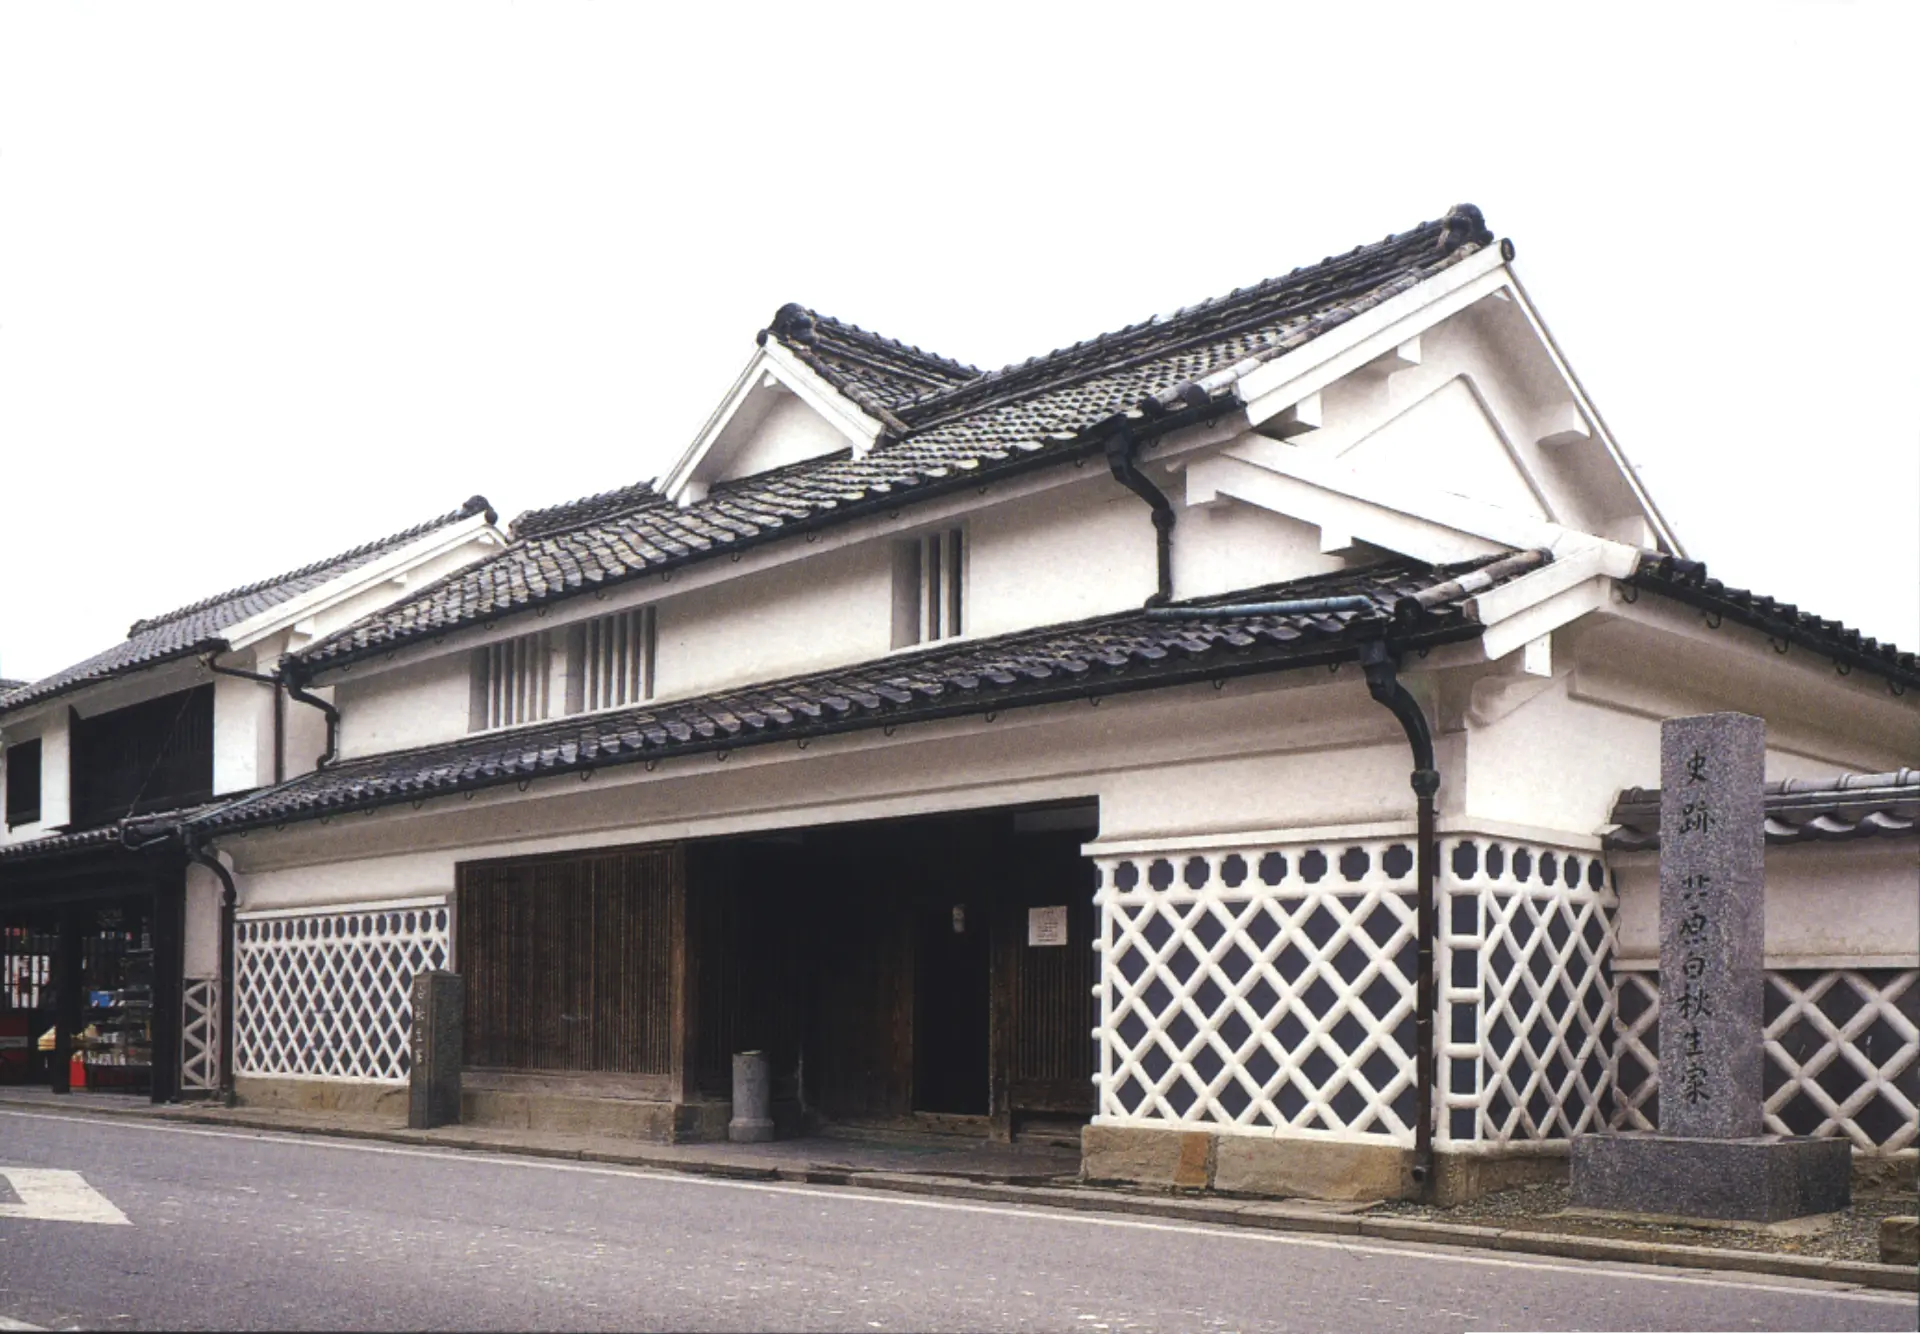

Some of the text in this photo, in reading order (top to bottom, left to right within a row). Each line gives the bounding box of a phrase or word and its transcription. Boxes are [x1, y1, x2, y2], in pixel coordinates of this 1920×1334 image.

[1677, 874, 1712, 1104] 北原白秋生家
